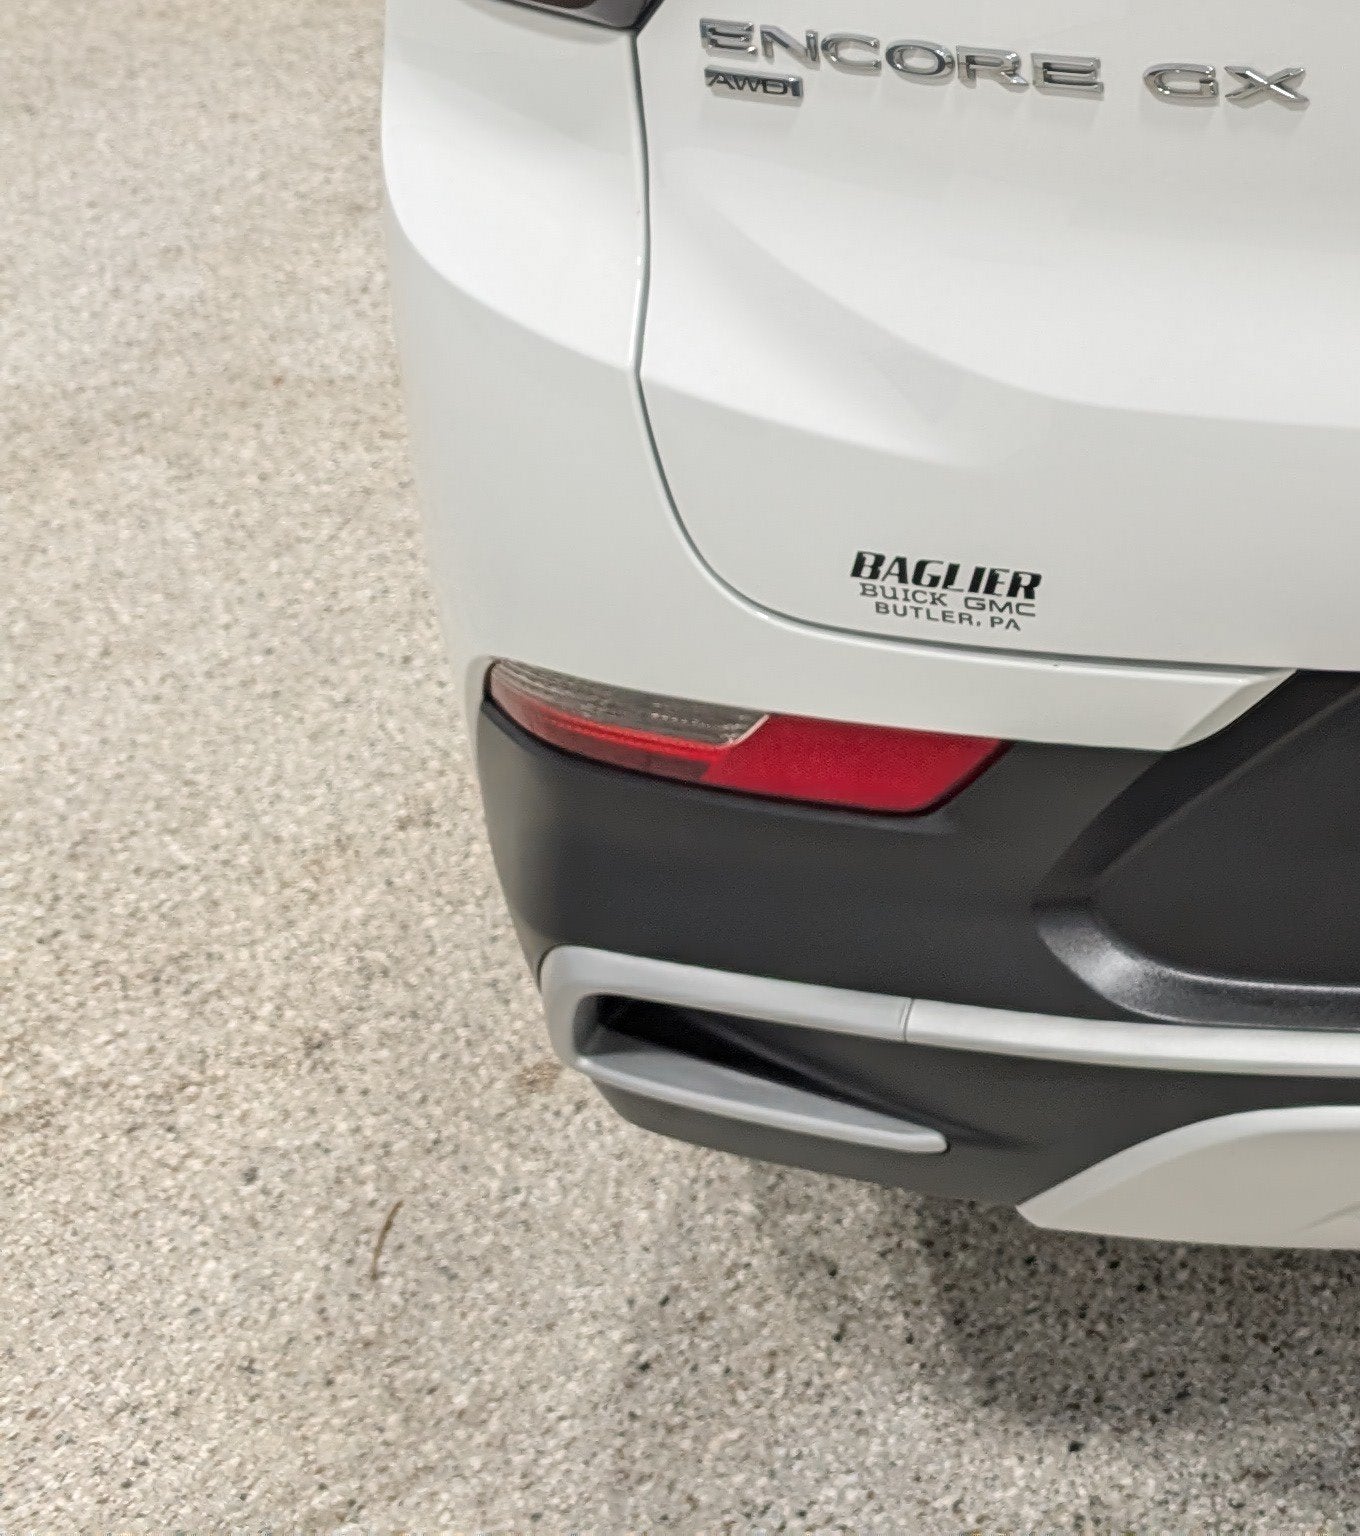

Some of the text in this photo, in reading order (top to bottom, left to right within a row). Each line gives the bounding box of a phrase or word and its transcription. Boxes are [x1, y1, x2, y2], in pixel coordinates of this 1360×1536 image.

[700, 17, 1309, 107] ENCORE GX
[707, 71, 789, 96] AWD
[850, 550, 1042, 600] BAGLIER
[859, 582, 1036, 617] BUICK GMC
[875, 601, 1021, 631] BUTLER, PA
